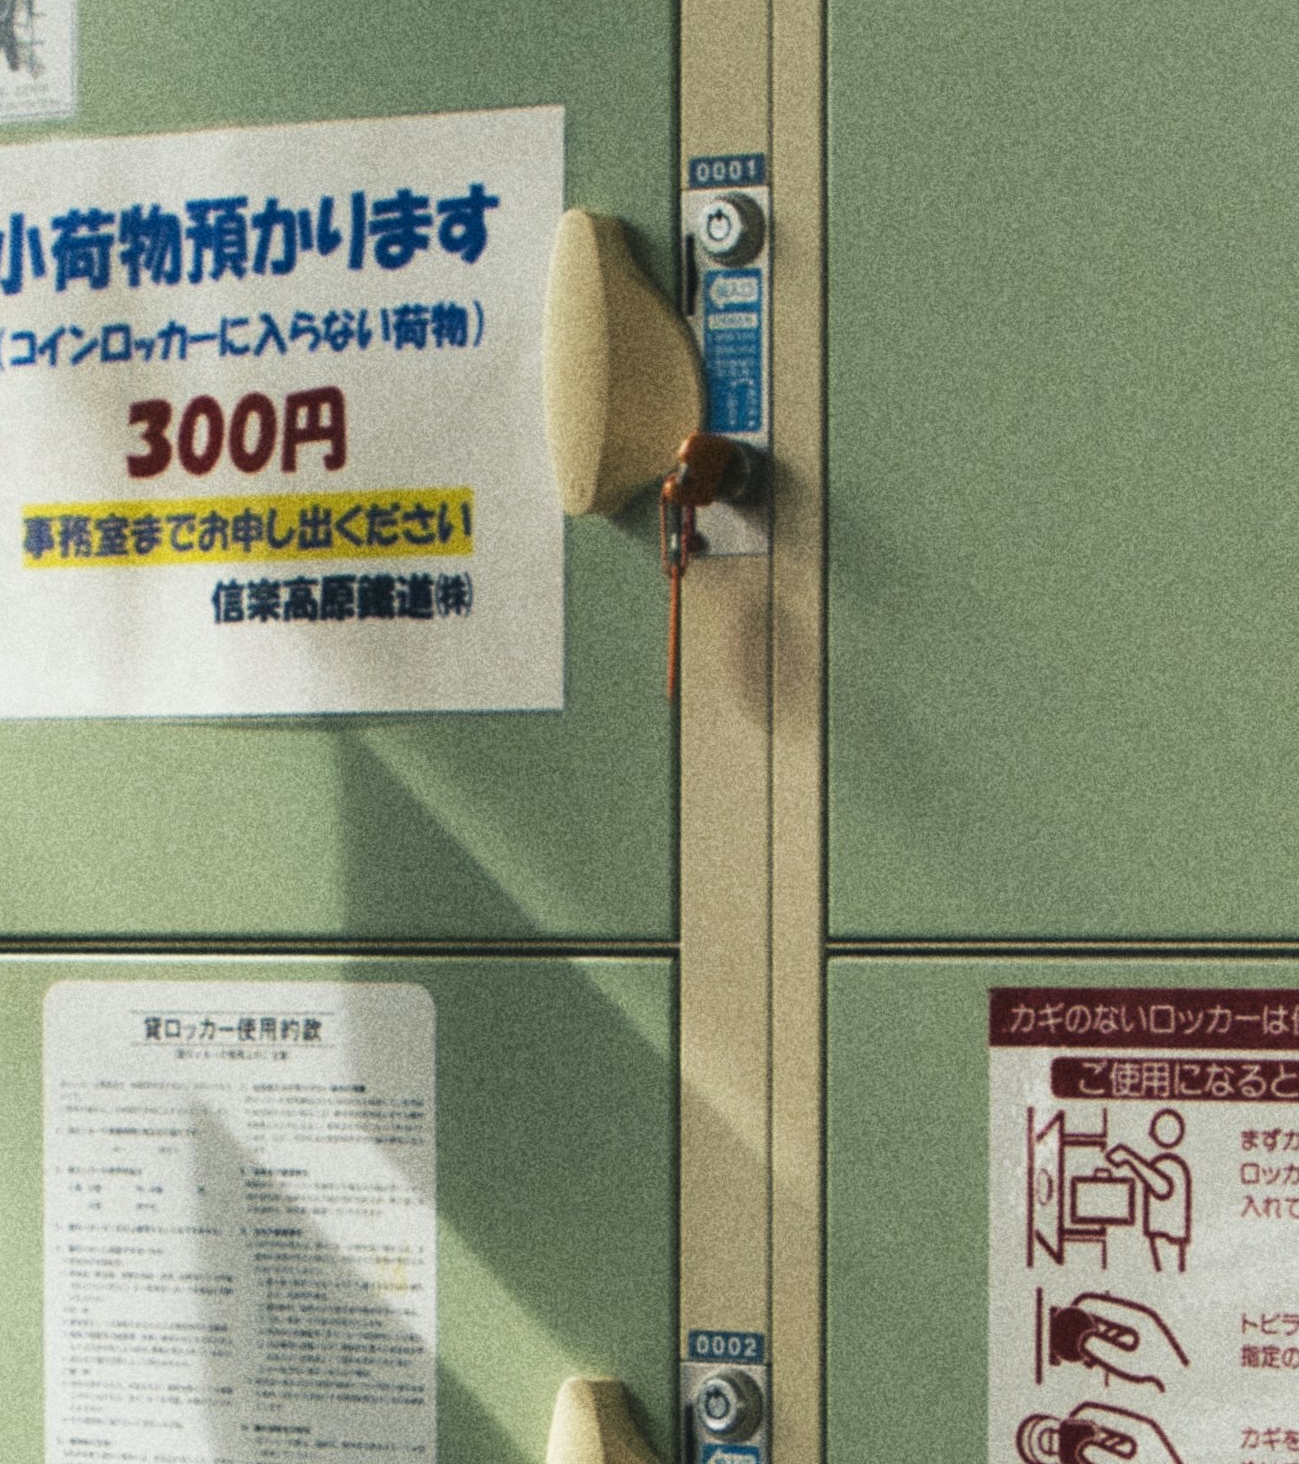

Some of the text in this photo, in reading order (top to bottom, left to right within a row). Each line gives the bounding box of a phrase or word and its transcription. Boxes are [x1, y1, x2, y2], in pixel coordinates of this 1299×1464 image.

[695, 159, 757, 183] 0001
[125, 384, 350, 480] 300円
[22, 502, 474, 560] 事務室までお申し出ください
[695, 1334, 758, 1357] 0002
